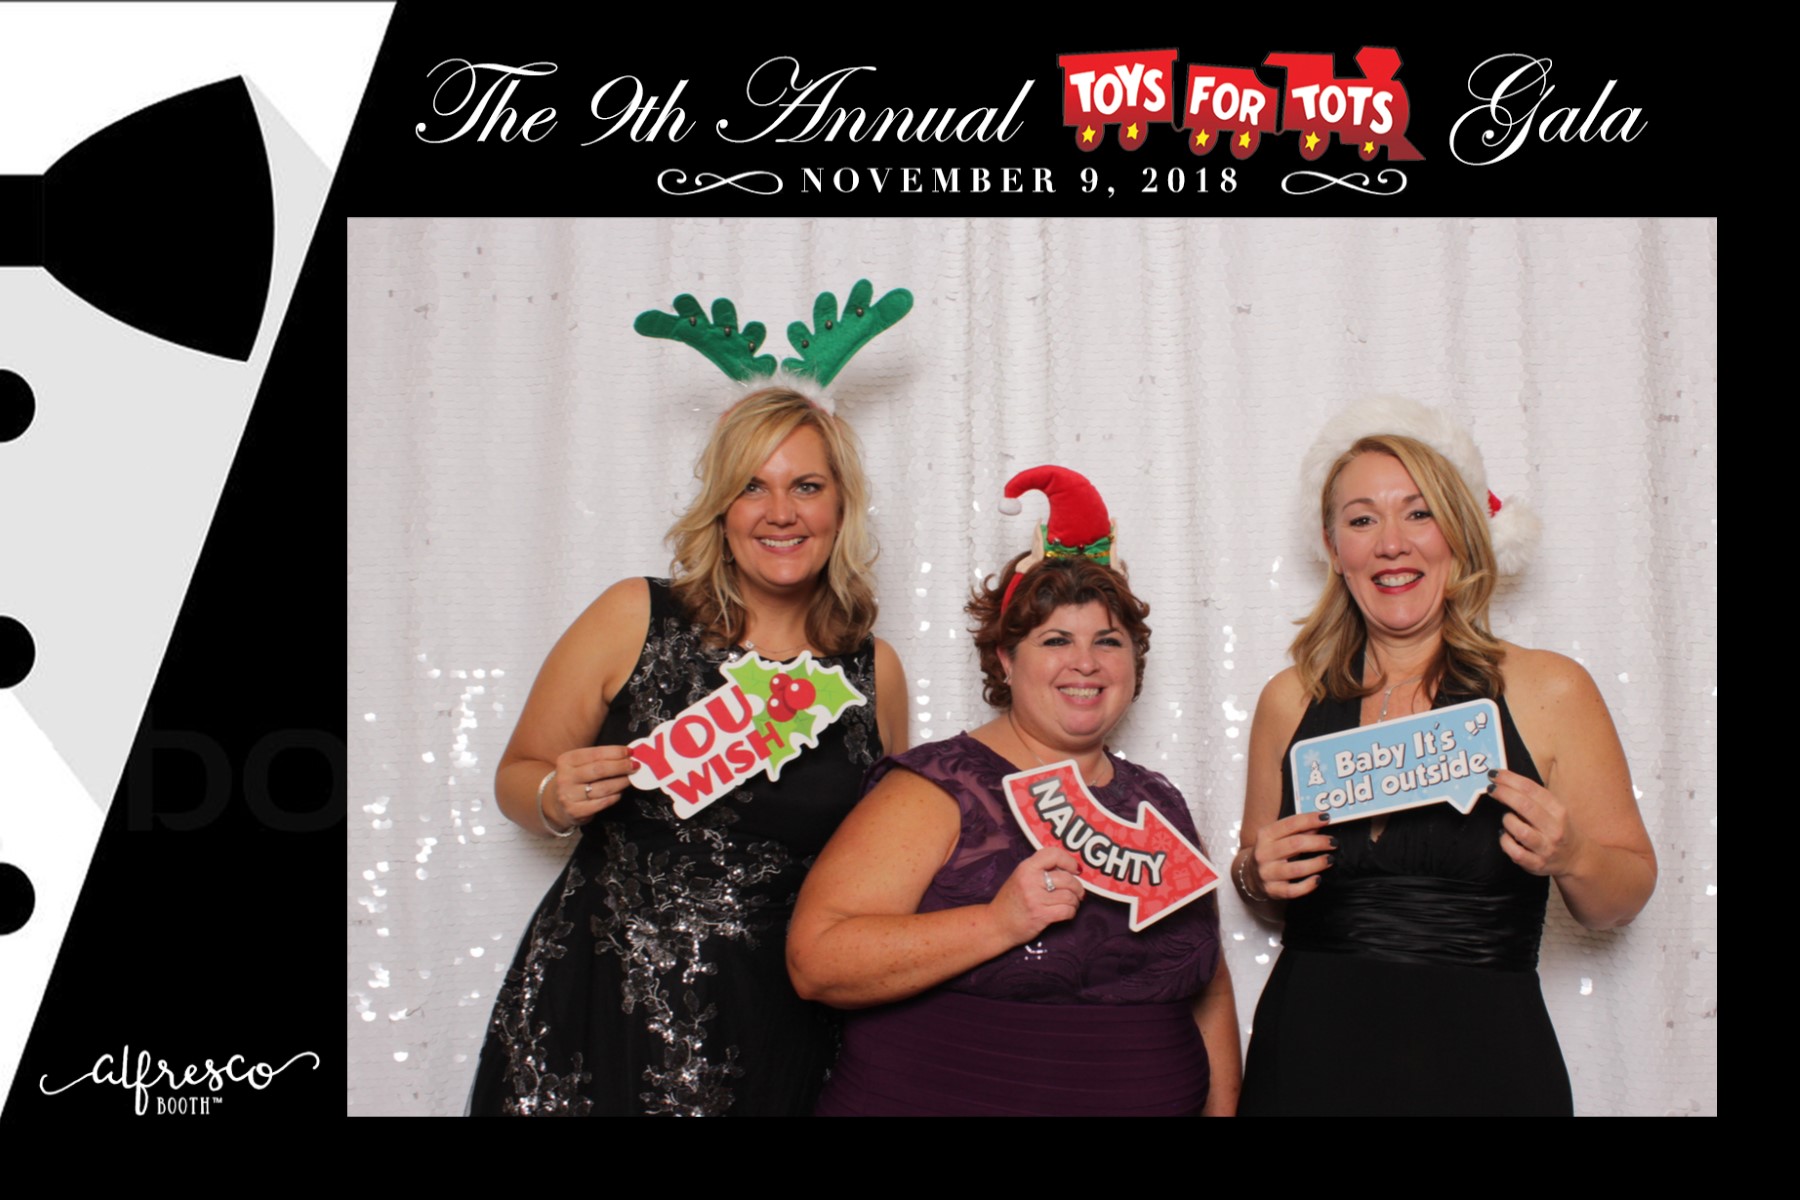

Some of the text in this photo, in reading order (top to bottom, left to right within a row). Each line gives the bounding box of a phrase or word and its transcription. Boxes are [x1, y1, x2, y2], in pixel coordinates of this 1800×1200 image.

[631, 685, 753, 781] YOU
[667, 721, 785, 805] WISH
[1334, 721, 1457, 779] Baby It's
[1313, 749, 1490, 812] cold outside
[1029, 776, 1166, 885] NAUGHTY
